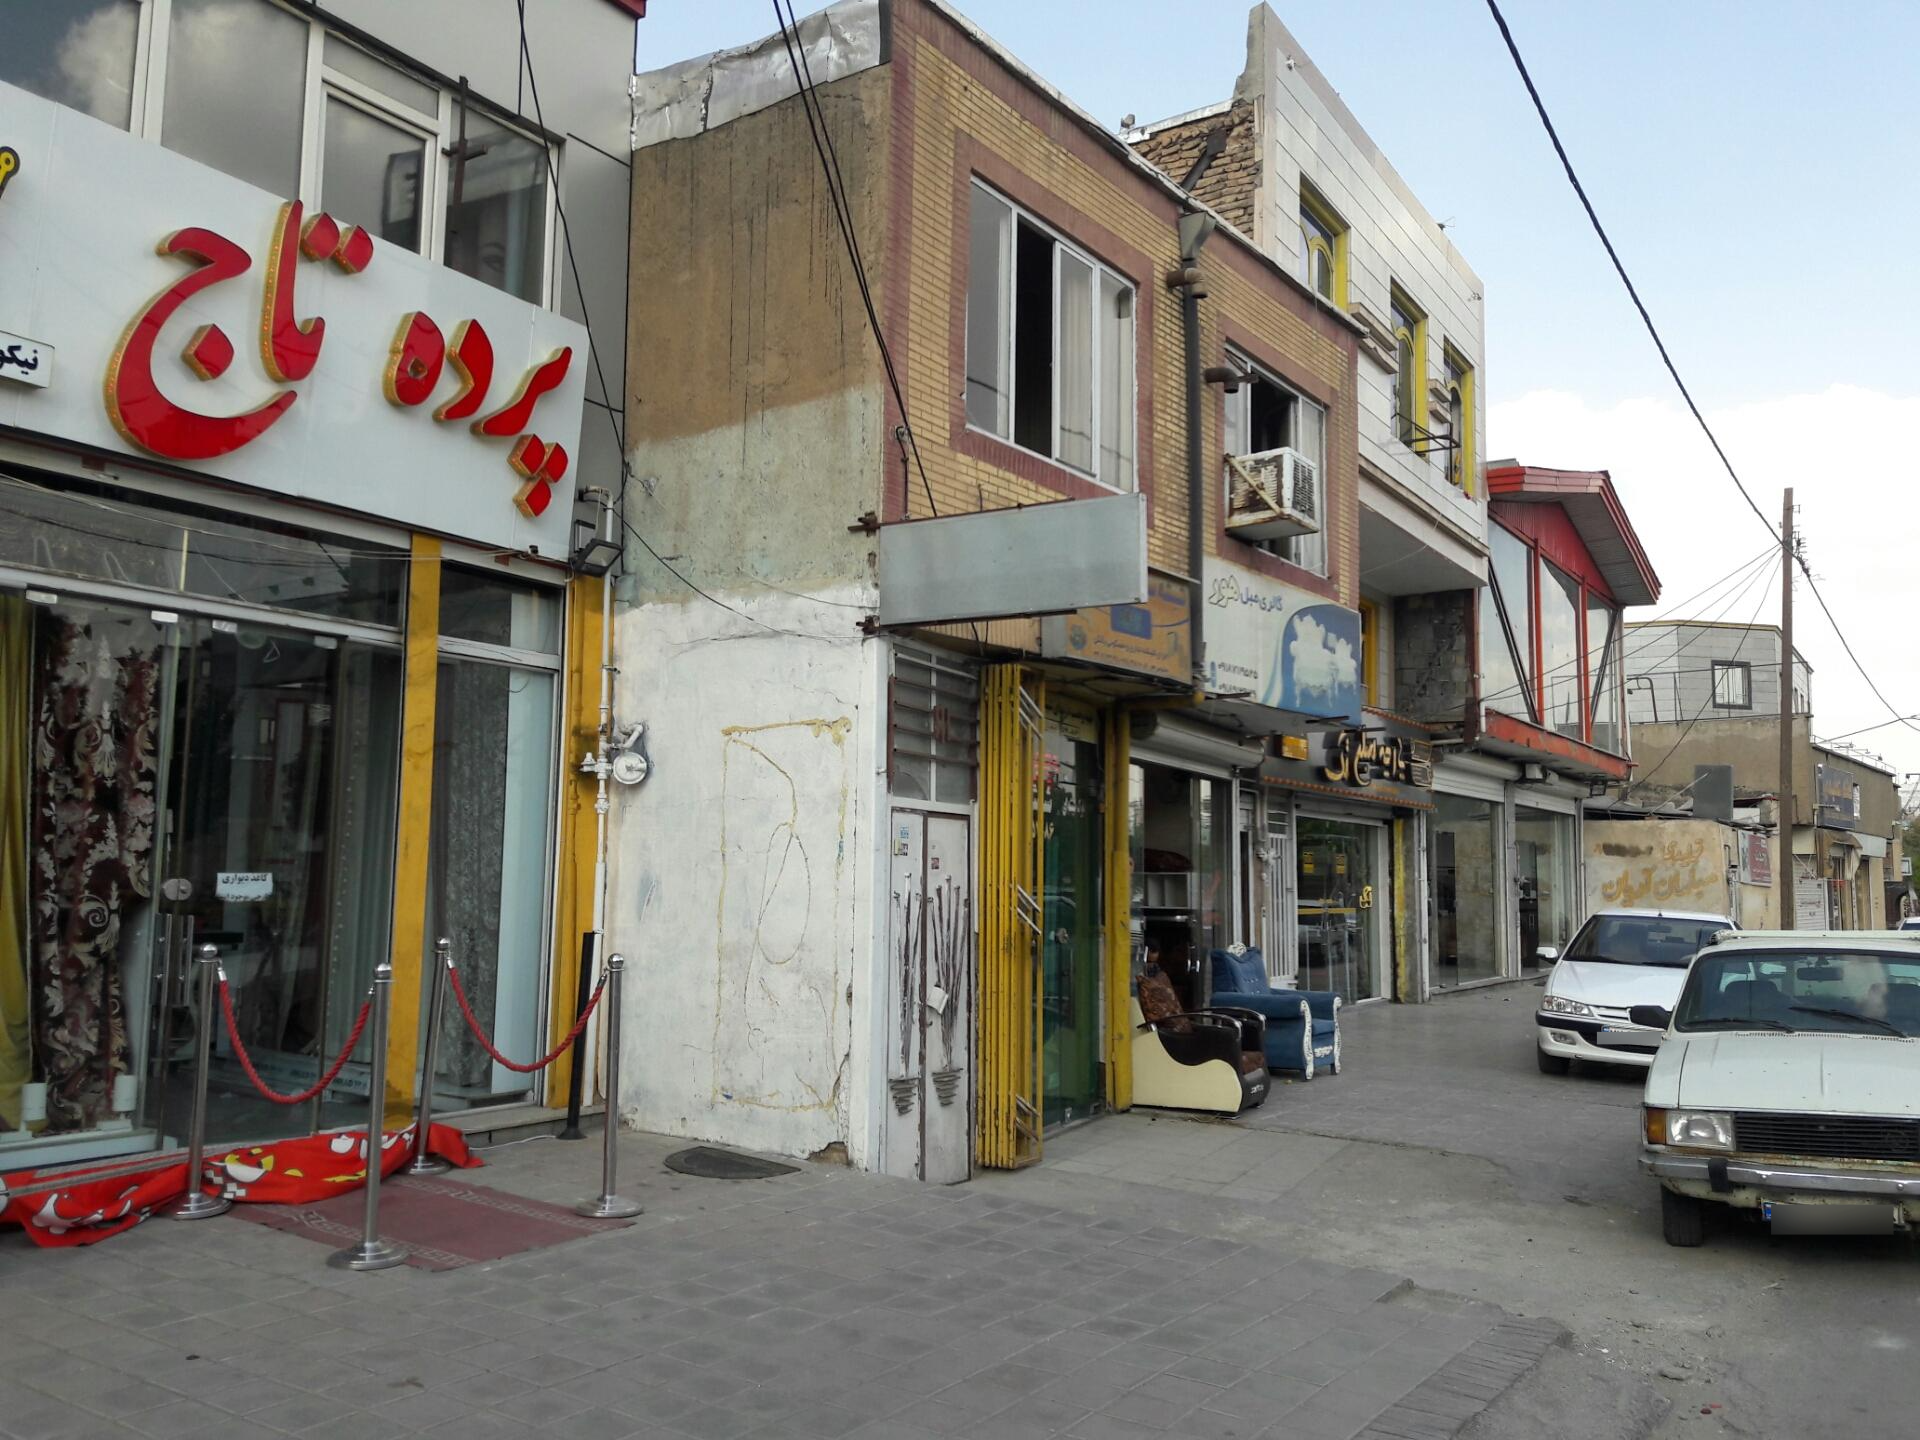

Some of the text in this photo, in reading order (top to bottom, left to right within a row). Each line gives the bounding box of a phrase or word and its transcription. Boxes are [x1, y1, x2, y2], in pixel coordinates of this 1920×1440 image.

[103, 199, 573, 520] پرده تاج
[1240, 587, 1260, 607] مبل
